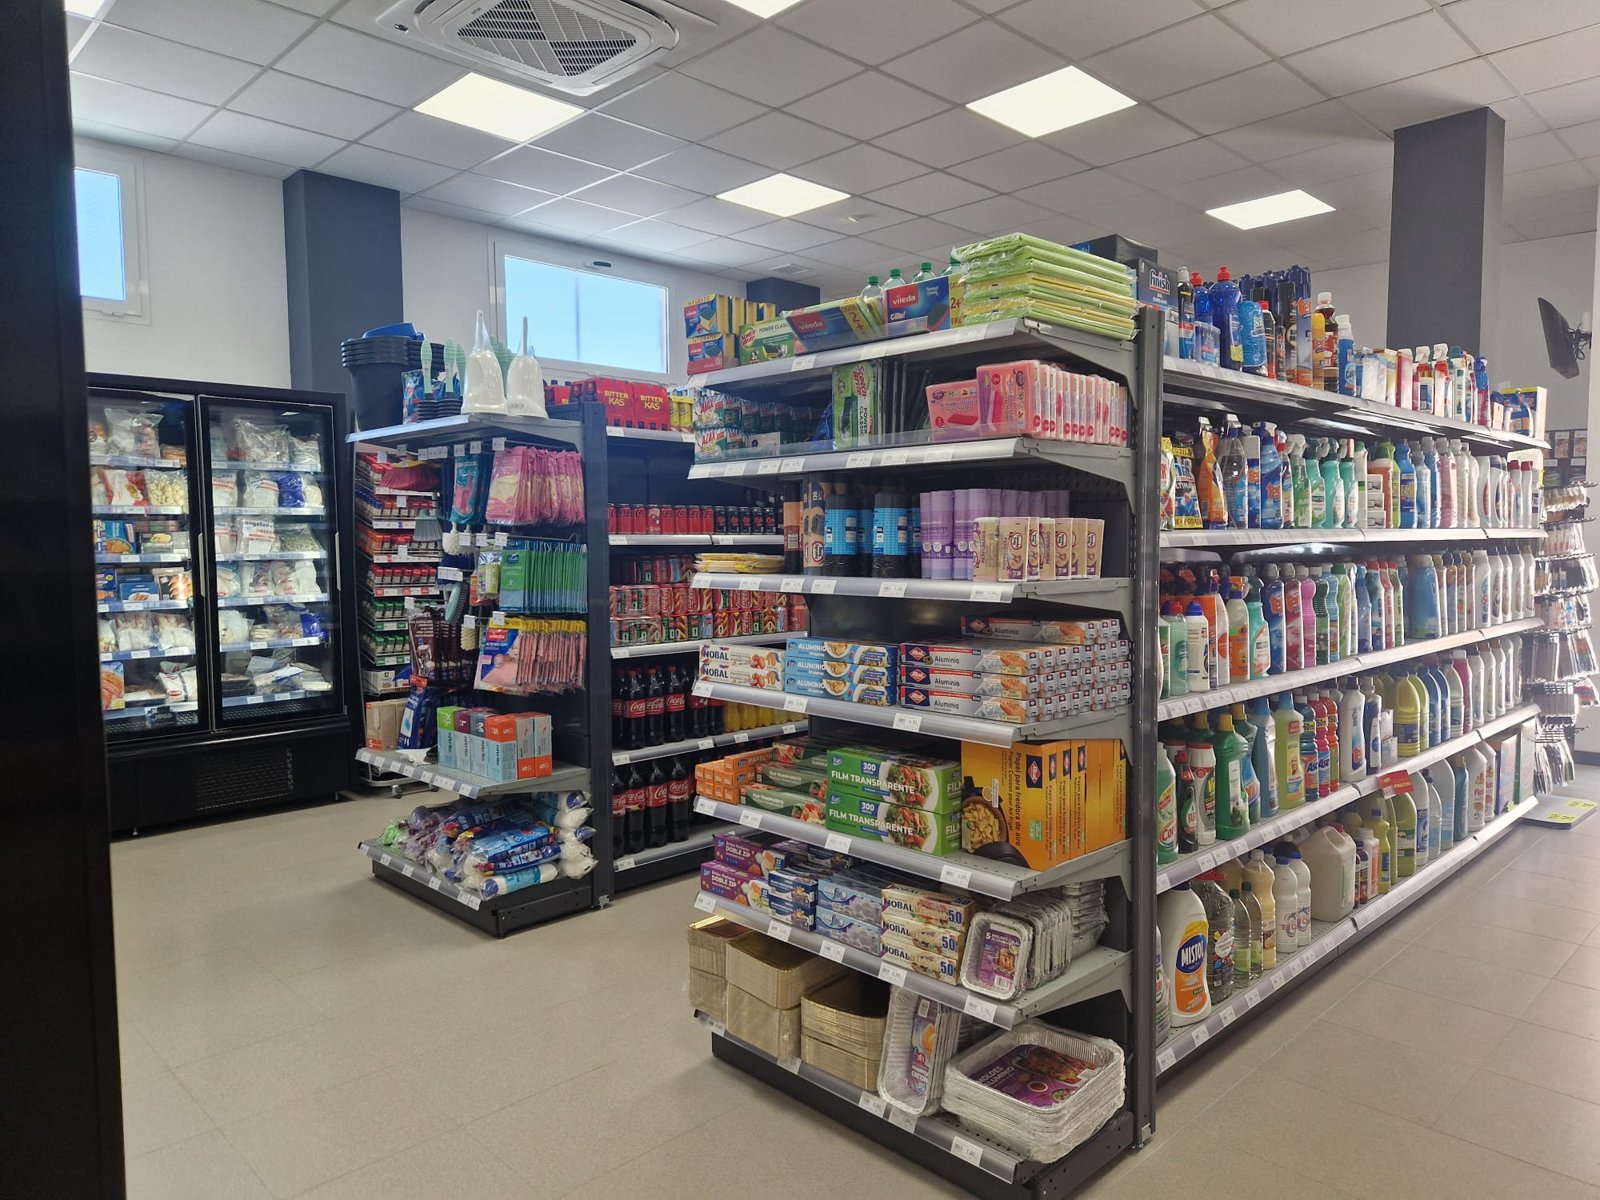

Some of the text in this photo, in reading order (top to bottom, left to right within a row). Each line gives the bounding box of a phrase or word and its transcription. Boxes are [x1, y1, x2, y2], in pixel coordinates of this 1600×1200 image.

[1150, 269, 1170, 290] finish
[892, 295, 916, 306] vileda
[800, 321, 824, 331] vileda
[604, 390, 629, 400] BITTER
[640, 394, 663, 403] BITTER
[608, 398, 625, 407] KAS
[644, 402, 660, 411] KAS
[994, 627, 1019, 636] Aluminio
[798, 643, 826, 653] ALUMINIO
[703, 650, 729, 660] NOBAL
[934, 656, 960, 664] Aluminio
[797, 661, 825, 671] ALUMINIO
[703, 668, 729, 678] NOBAL
[797, 679, 825, 689] ALUMINIO
[934, 679, 960, 687] Aluminio
[933, 700, 960, 709] Aluminio
[863, 762, 876, 771] 300
[831, 771, 849, 781] FILM
[850, 775, 915, 794] TRANSPARENTE
[861, 802, 875, 811] 300
[829, 809, 914, 836] FILM TRANSPARENTE
[1015, 821, 1022, 831] de
[726, 846, 751, 858] DOBLE ZIP
[711, 875, 737, 888] DOBLE ZIP
[883, 898, 962, 924] NOBAL 50
[882, 921, 956, 951] NOBAL 50
[985, 932, 991, 940] 5
[1181, 940, 1204, 967] MISTOL
[881, 943, 954, 976] NOBAL 50
